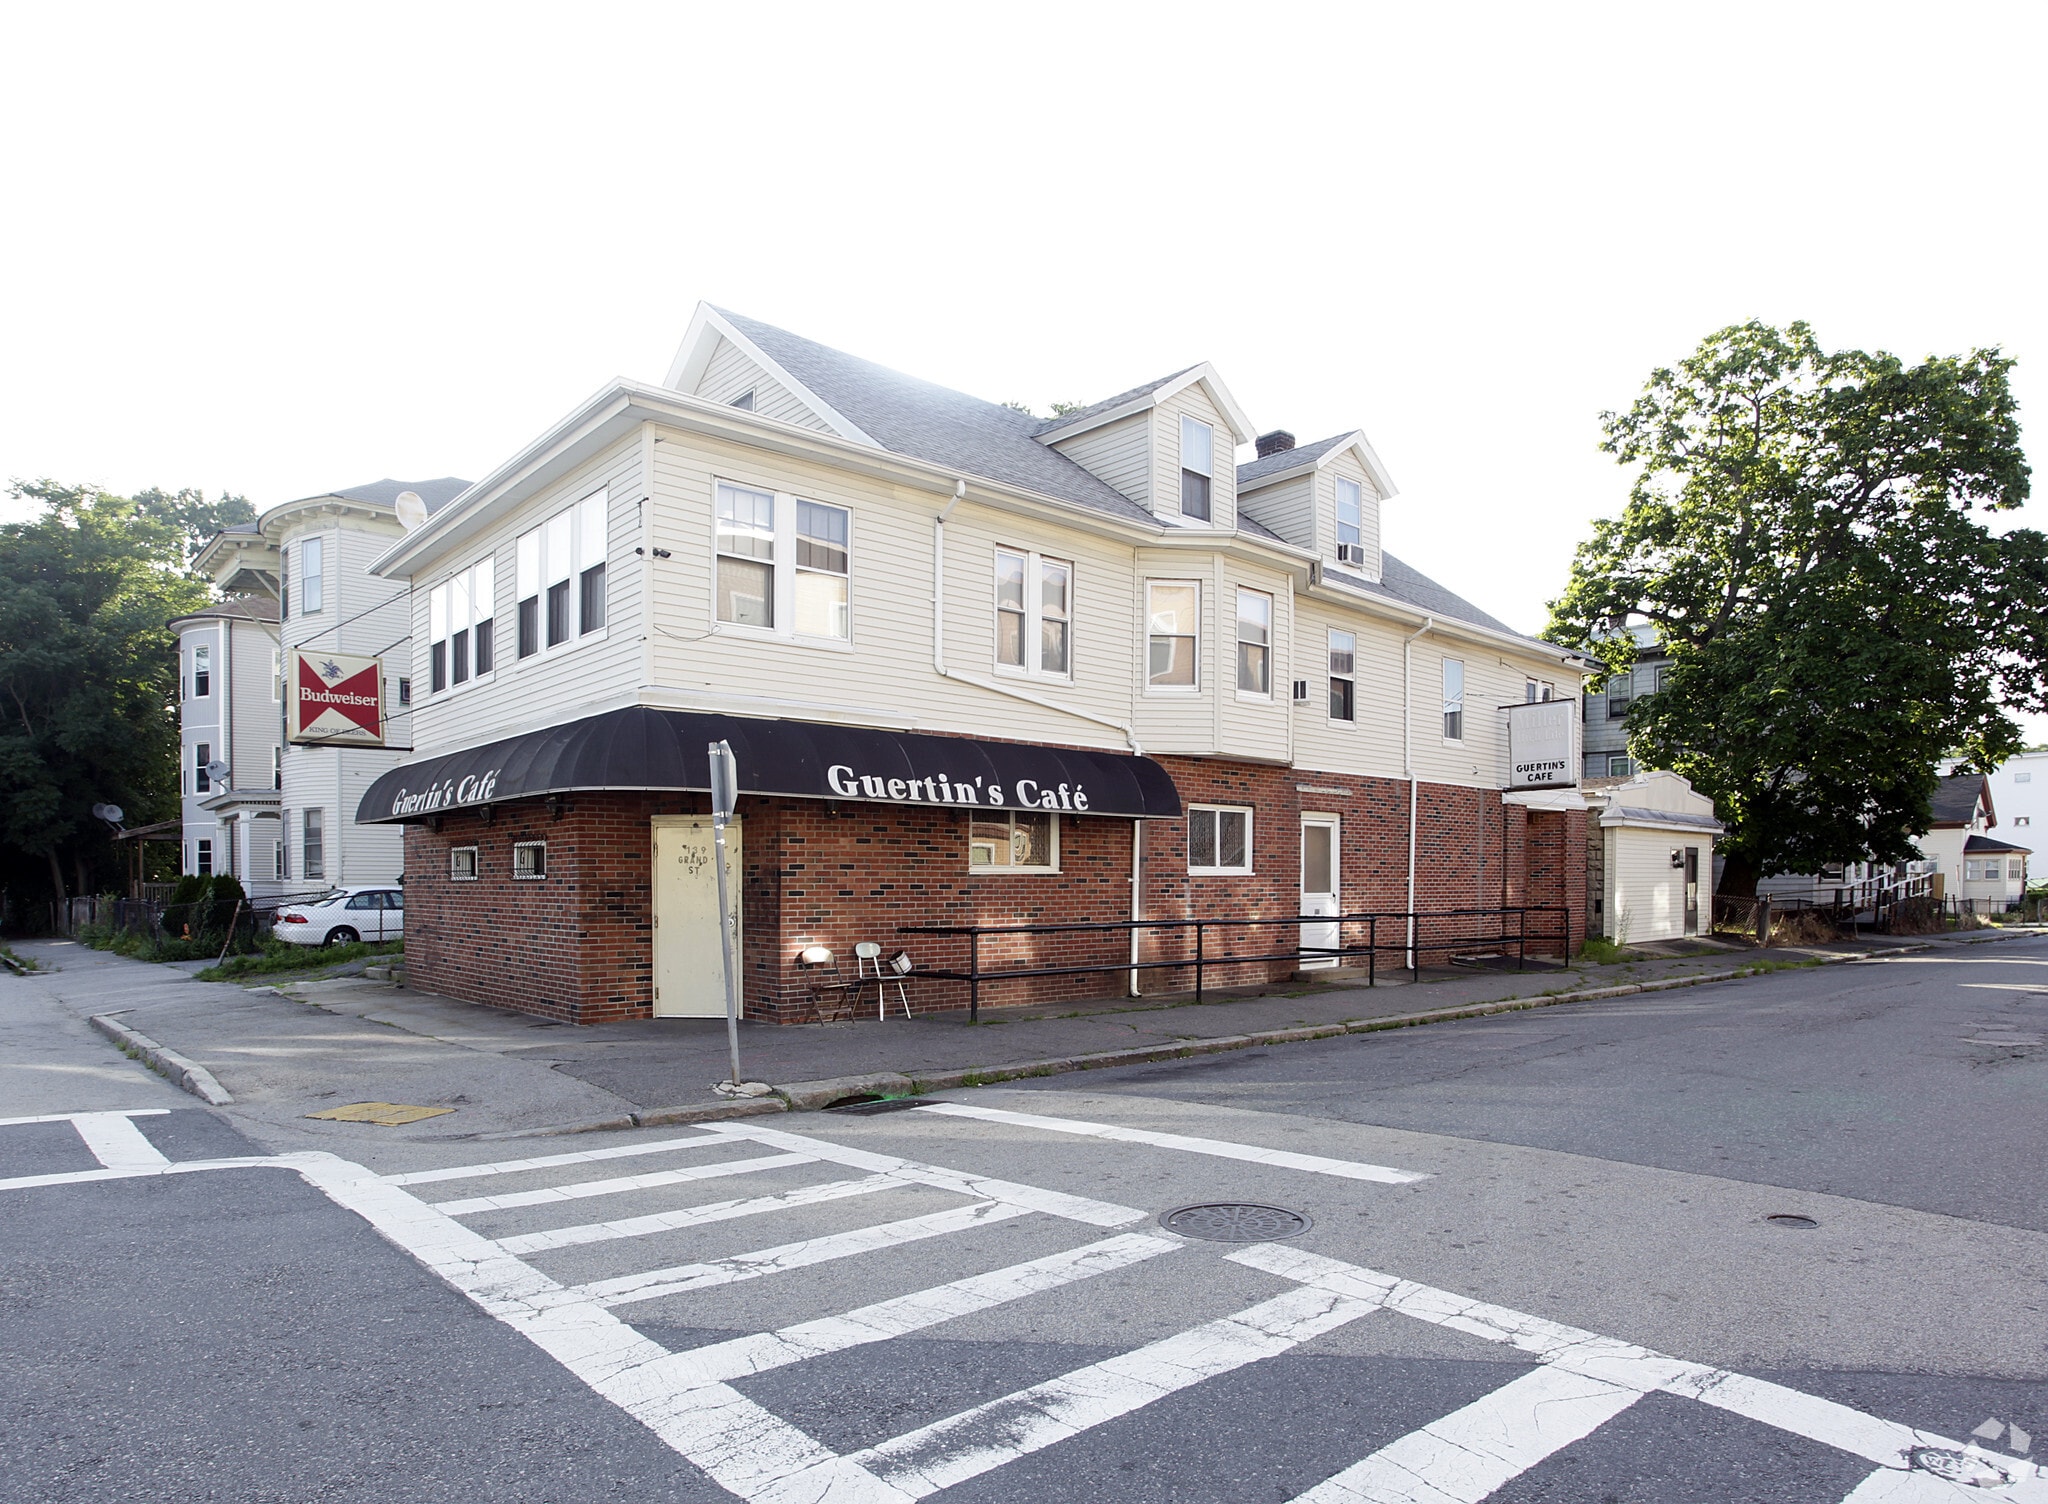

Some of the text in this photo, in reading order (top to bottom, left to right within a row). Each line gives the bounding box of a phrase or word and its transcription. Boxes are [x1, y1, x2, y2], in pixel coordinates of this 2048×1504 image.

[300, 687, 378, 707] Budweiser
[309, 726, 328, 734] KING
[1516, 760, 1565, 773] GUERTIN'S
[1527, 771, 1553, 782] CAFE
[392, 769, 502, 816] Guertin's Café
[827, 764, 1090, 812] Guertin's Café
[687, 846, 707, 855] 139
[678, 856, 708, 865] GRAND
[688, 866, 700, 875] ST
